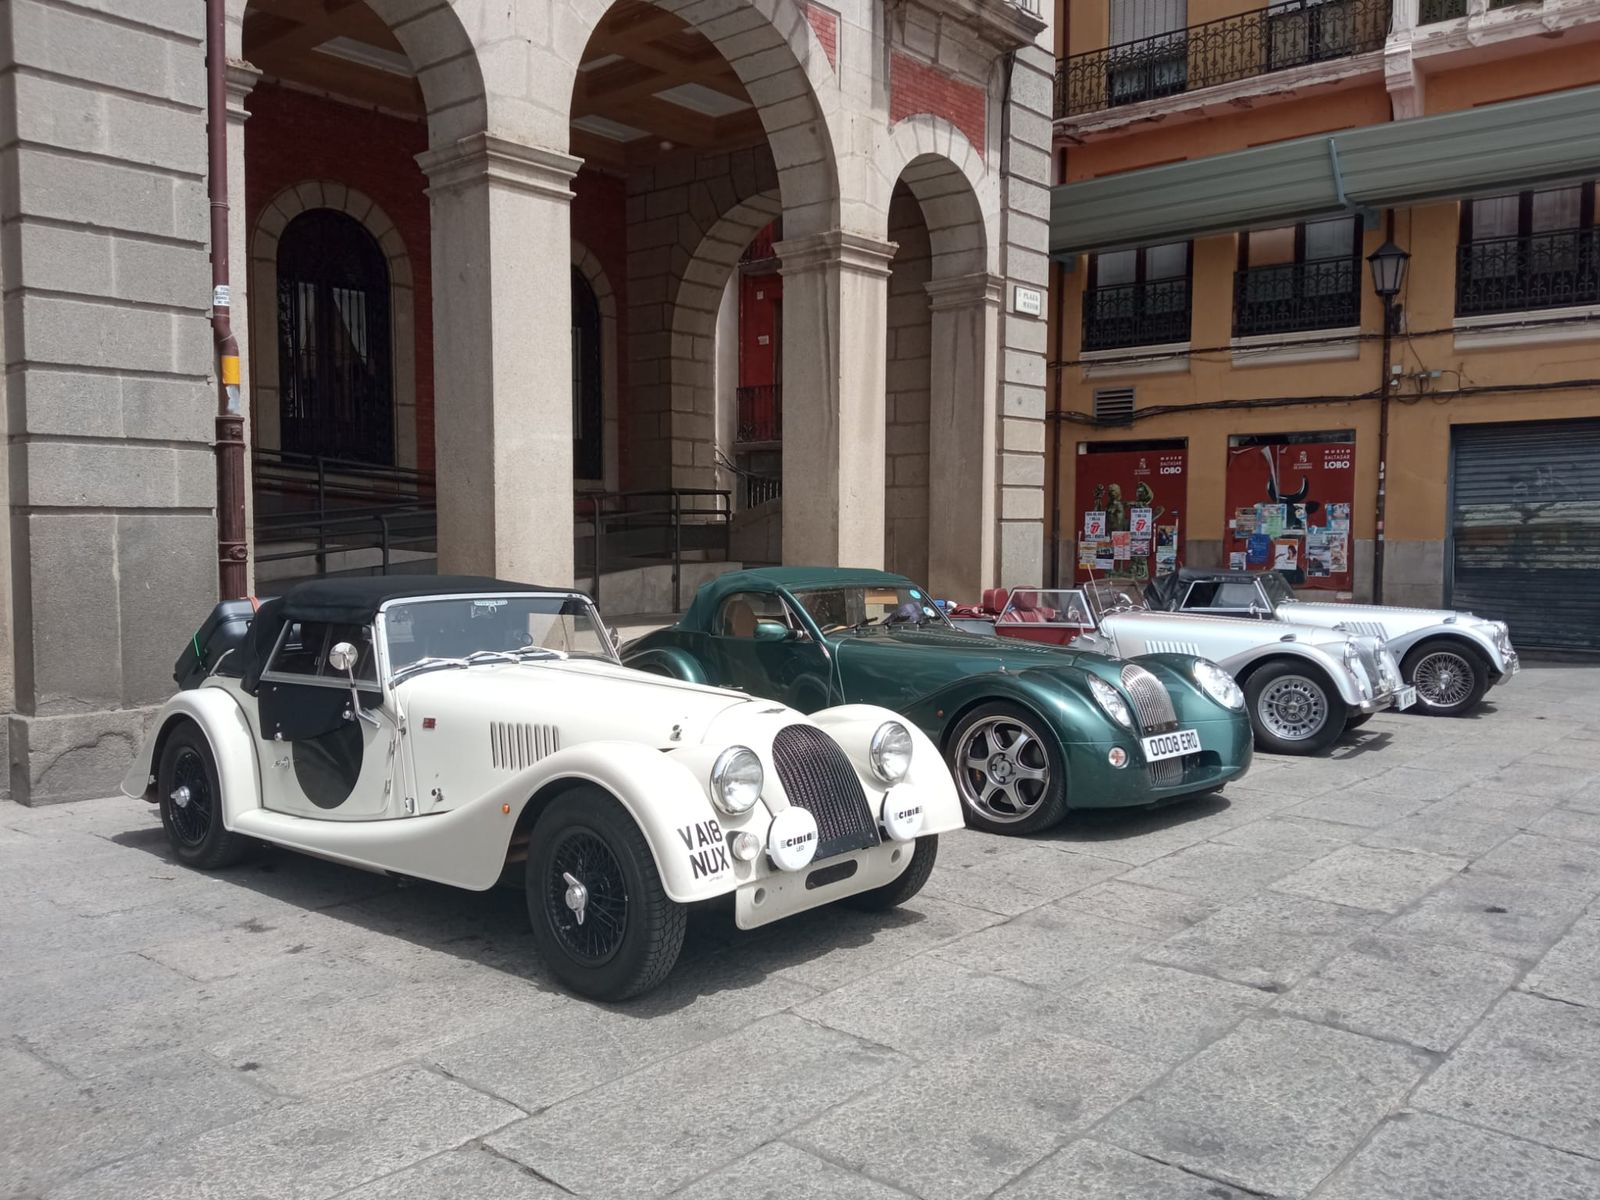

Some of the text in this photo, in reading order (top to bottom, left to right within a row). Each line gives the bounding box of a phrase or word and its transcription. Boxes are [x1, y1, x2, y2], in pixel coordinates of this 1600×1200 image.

[1160, 466, 1182, 475] LOBO
[1324, 460, 1350, 469] LOBO
[677, 819, 723, 850] VA18
[786, 831, 813, 847] CIBIE
[689, 845, 730, 879] NUX
